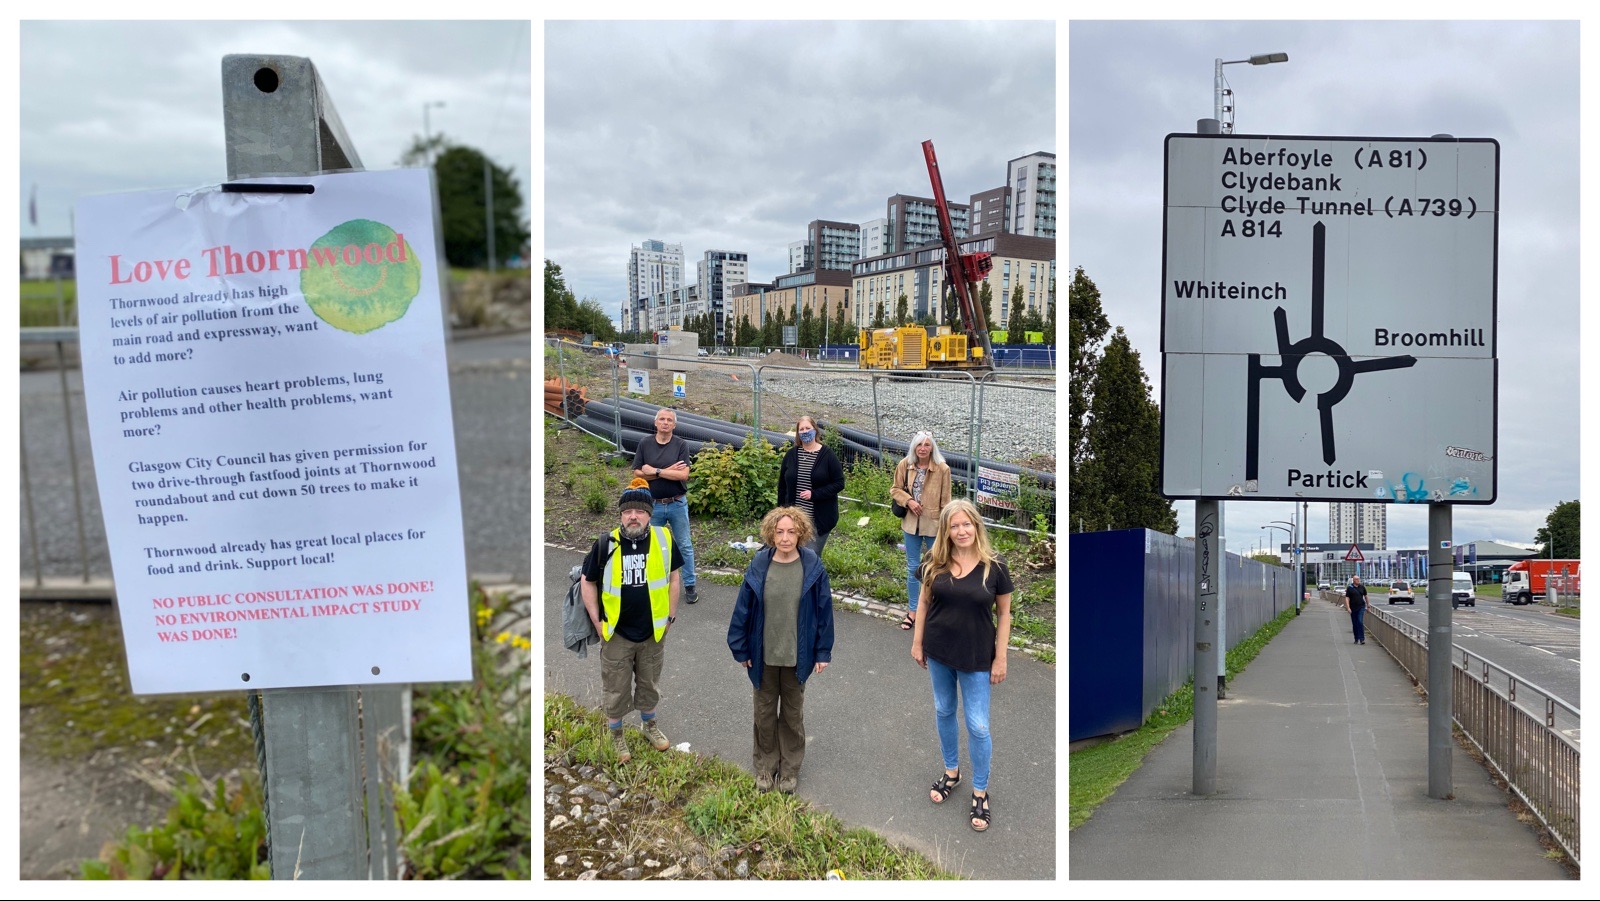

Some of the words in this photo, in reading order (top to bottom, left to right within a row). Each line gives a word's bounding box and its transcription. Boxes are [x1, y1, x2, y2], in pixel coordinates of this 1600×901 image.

[1222, 147, 1333, 170] Aberfoyle
[1221, 172, 1342, 193] Clydebank
[1221, 196, 1286, 217] Clyde
[1297, 197, 1374, 216] Tunnel
[108, 253, 191, 285] Love
[202, 233, 408, 279] Thornwood
[109, 293, 179, 309] Thornwood
[183, 290, 228, 303] already
[232, 289, 254, 299] has
[258, 285, 288, 299] high
[1174, 280, 1287, 300] Whiteinch
[110, 315, 142, 328] levels
[146, 313, 159, 325] of
[161, 312, 178, 324] air
[181, 308, 237, 326] pollution
[241, 306, 274, 317] from
[278, 303, 299, 314] the
[112, 334, 142, 346] main
[145, 331, 173, 344] road
[177, 328, 200, 341] and
[203, 326, 281, 342] expressway,
[285, 320, 318, 332] want
[1374, 328, 1485, 347] Broomhill
[113, 355, 125, 365] to
[129, 351, 151, 364] add
[155, 348, 193, 362] more?
[118, 389, 138, 401] Air
[141, 386, 197, 403] pollution
[201, 385, 242, 395] causes
[245, 380, 280, 392] heart
[284, 375, 349, 392] problems,
[353, 372, 384, 384] lung
[120, 406, 178, 423] problems
[181, 402, 205, 415] and
[208, 401, 242, 413] other
[245, 396, 287, 410] health
[290, 393, 356, 410] problems,
[360, 388, 392, 400] want
[123, 424, 161, 437] more?
[128, 461, 181, 474] Glasgow
[185, 457, 212, 470] City
[216, 452, 266, 466] Council
[269, 452, 291, 462] has
[294, 449, 329, 463] given
[333, 442, 404, 461] permission
[408, 440, 427, 451] for
[131, 480, 154, 490] two
[157, 472, 245, 488] drive-through
[249, 467, 300, 482] fastfood
[304, 466, 340, 481] joints
[344, 464, 356, 474] at
[359, 456, 436, 473] Thornwood
[1287, 469, 1368, 489] Partick
[135, 493, 208, 507] roundabout
[212, 490, 235, 502] and
[239, 490, 259, 500] cut
[262, 487, 297, 498] down
[300, 484, 315, 495] 50
[319, 484, 350, 494] trees
[353, 482, 366, 491] to
[370, 478, 405, 490] make
[409, 476, 418, 487] it
[137, 514, 188, 526] happen.
[143, 543, 217, 558] Thornwood
[220, 540, 266, 553] already
[270, 539, 291, 550] has
[295, 536, 327, 551] great
[331, 532, 361, 545] local
[364, 531, 403, 546] places
[407, 528, 425, 540] for
[147, 563, 174, 575] food
[178, 561, 201, 573] and
[205, 559, 243, 571] drink.
[246, 556, 297, 571] Support
[300, 552, 334, 565] local!
[623, 554, 645, 569] MUSIC
[152, 597, 174, 609] NO
[177, 593, 231, 607] PUBLIC
[235, 586, 348, 604] CONSULTATION
[352, 584, 383, 596] WAS
[387, 581, 434, 594] DONE!
[155, 614, 176, 626] NO
[180, 606, 309, 624] ENVIRONMENTAL
[312, 602, 369, 617] IMPACT
[373, 599, 421, 613] STUDY
[157, 631, 188, 642] WAS
[192, 627, 237, 641] DONE!
